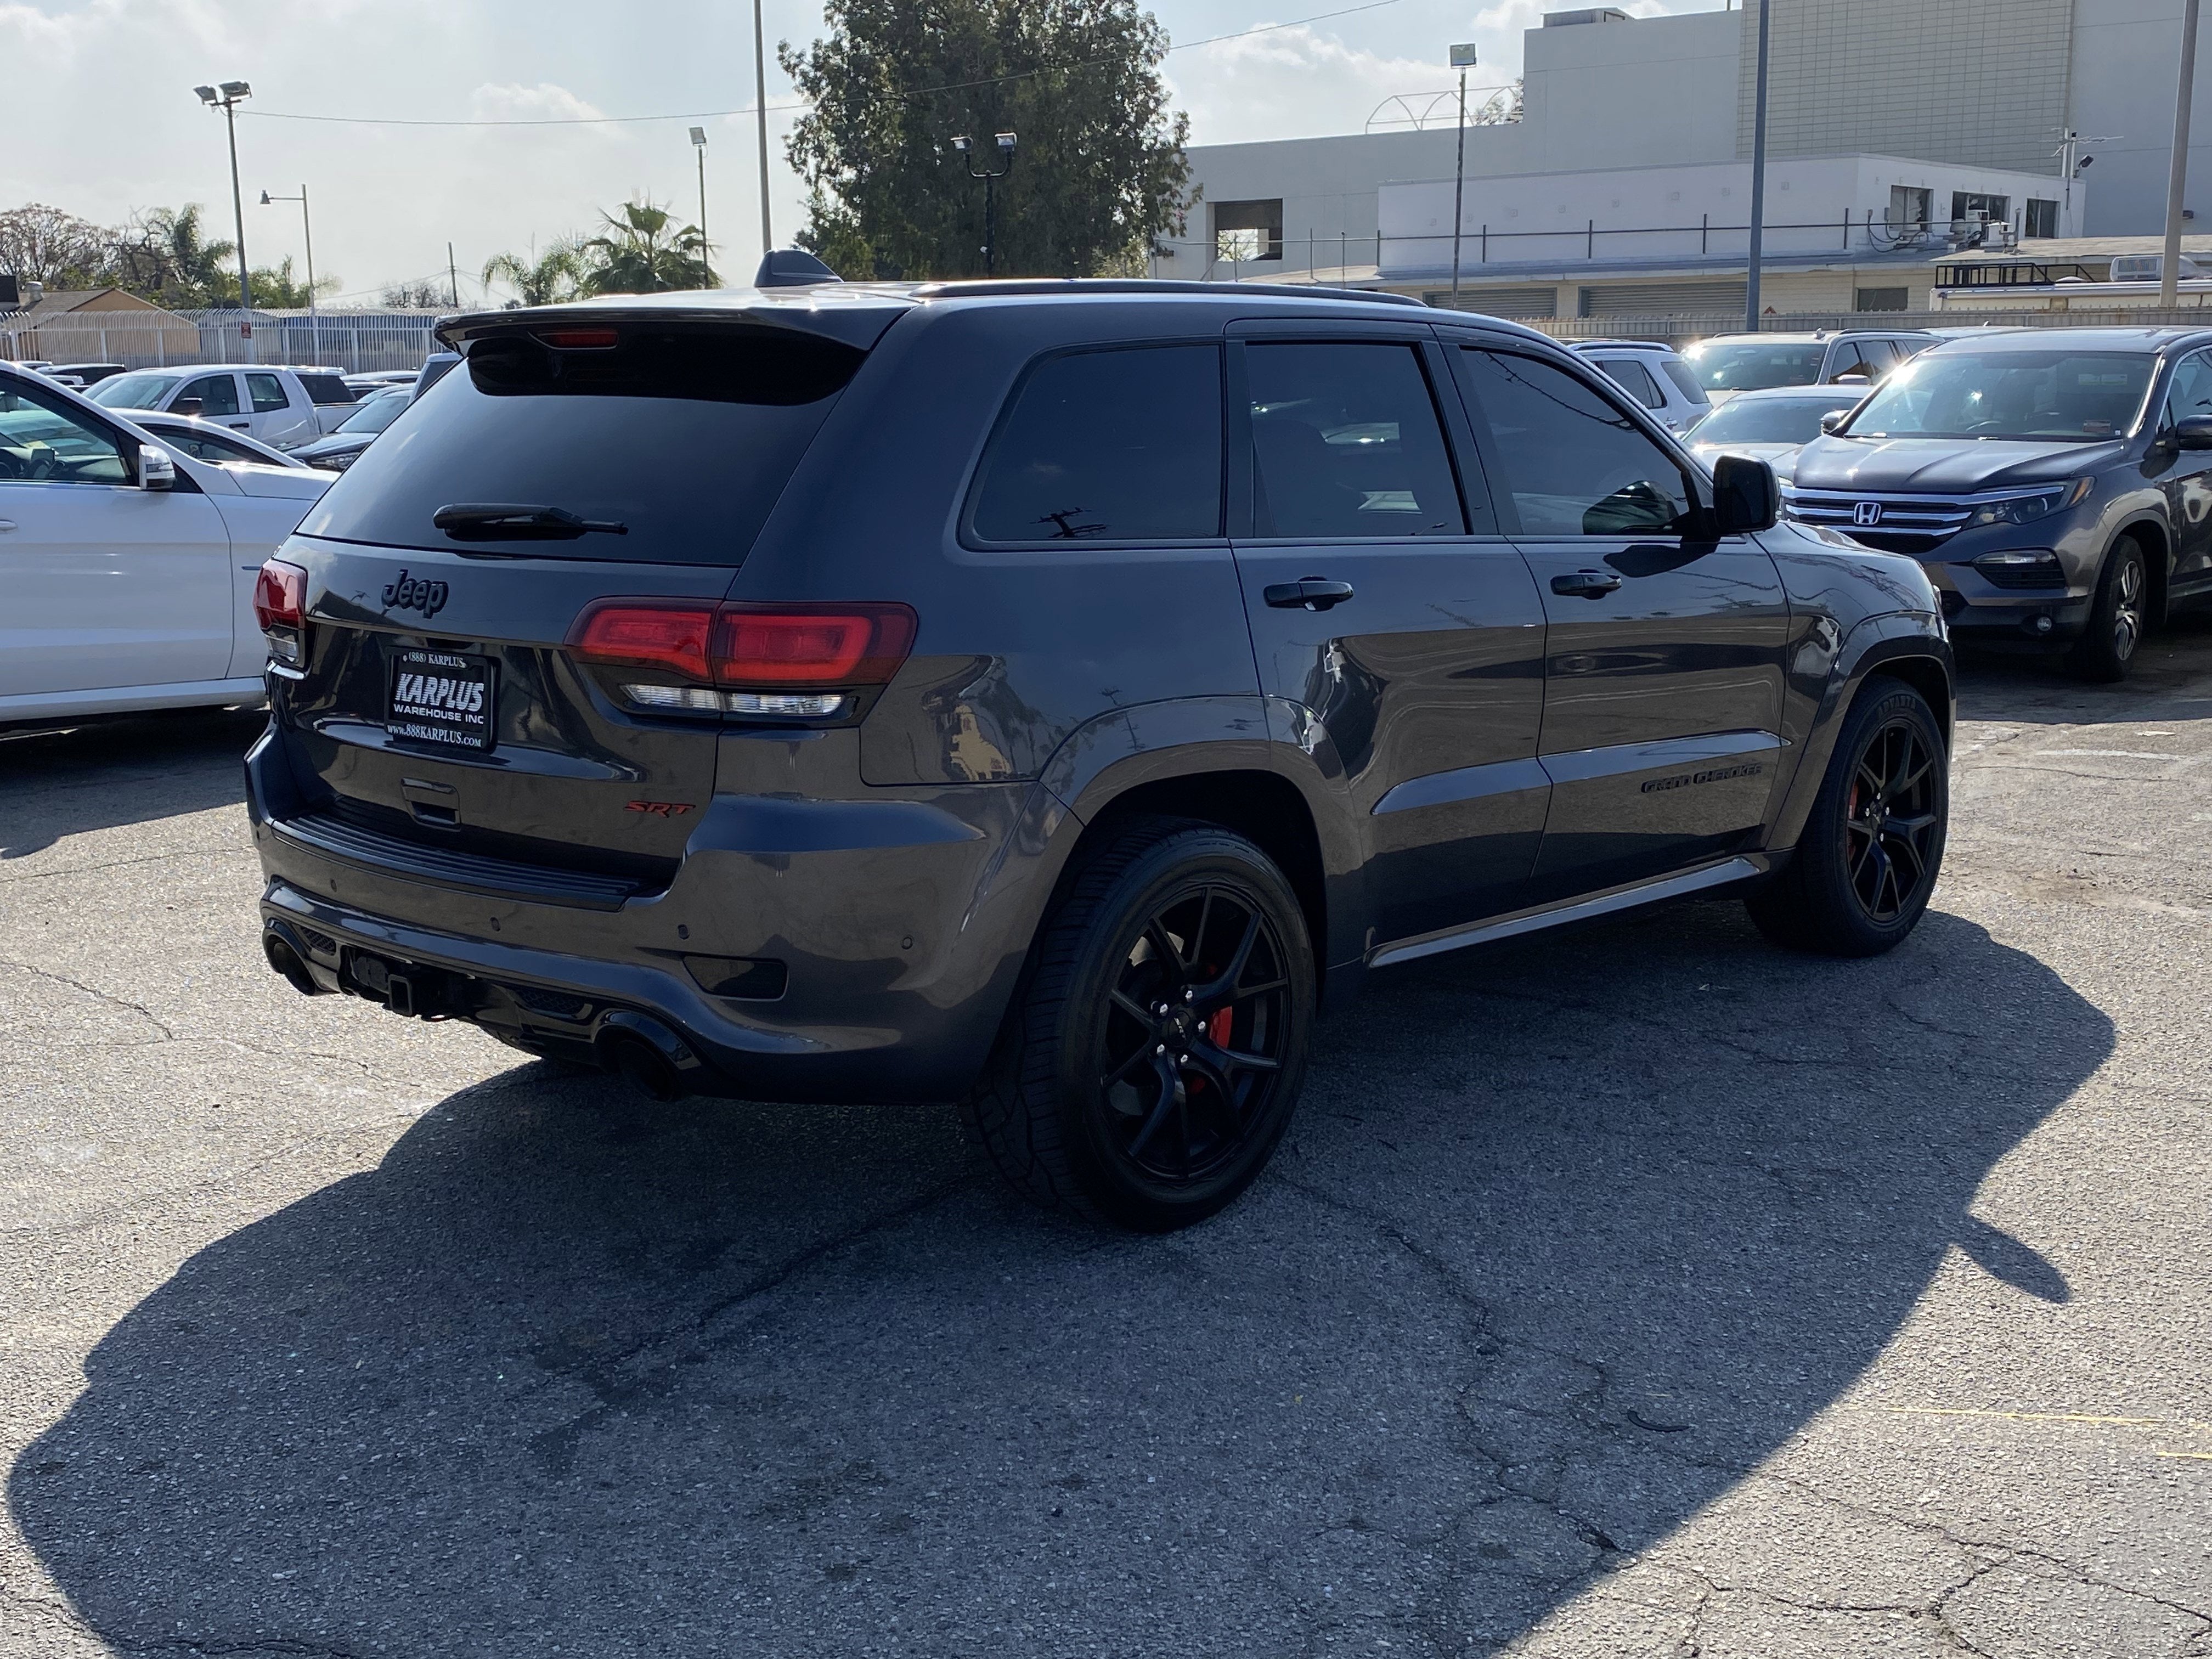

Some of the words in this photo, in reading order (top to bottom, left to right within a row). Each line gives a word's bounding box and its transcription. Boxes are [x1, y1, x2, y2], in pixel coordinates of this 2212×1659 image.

[382, 569, 449, 619] Jeep
[409, 652, 426, 663] (888)
[428, 654, 464, 668] KARPLUS
[395, 673, 484, 712] KARPLUS
[393, 704, 461, 721] WAREHOUSE
[465, 714, 484, 724] INC
[623, 800, 696, 818] SRT
